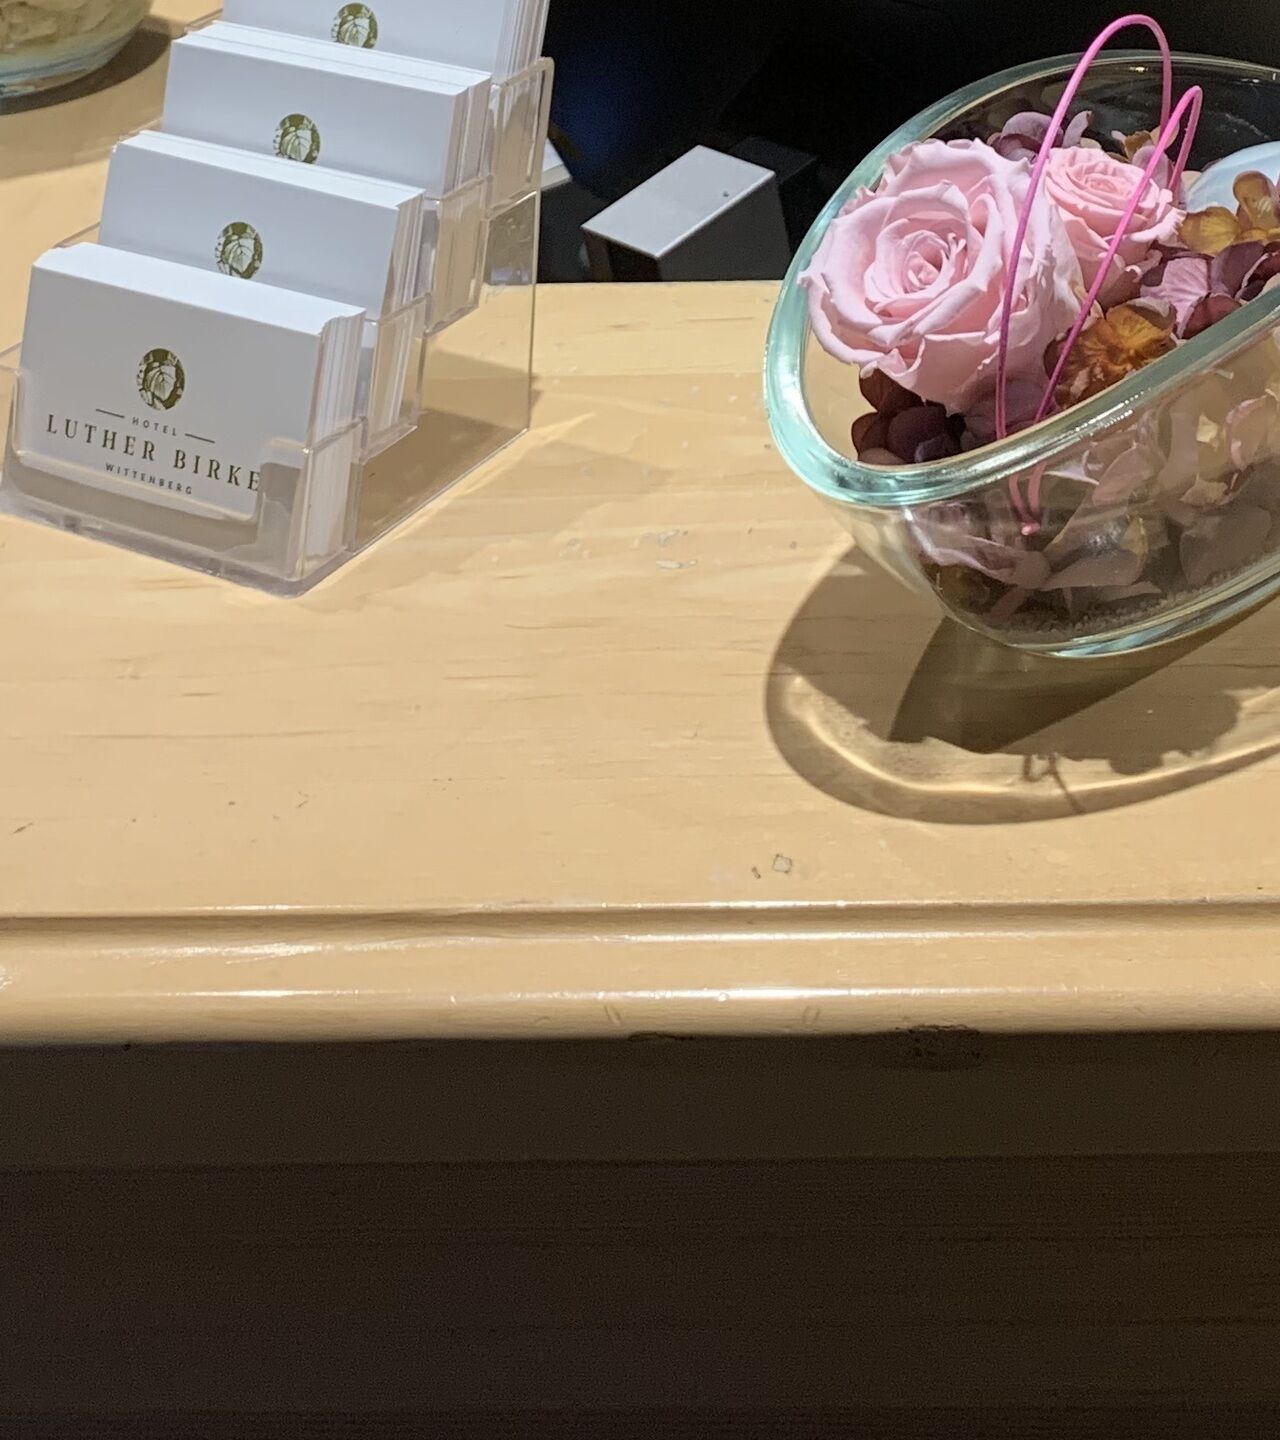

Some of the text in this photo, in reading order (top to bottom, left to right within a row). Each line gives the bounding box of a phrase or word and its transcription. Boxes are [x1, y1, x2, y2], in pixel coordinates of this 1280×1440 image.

[131, 415, 179, 437] HOTEL
[46, 414, 260, 492] LUTHER BIRKE
[105, 461, 193, 496] WITTENBERG
